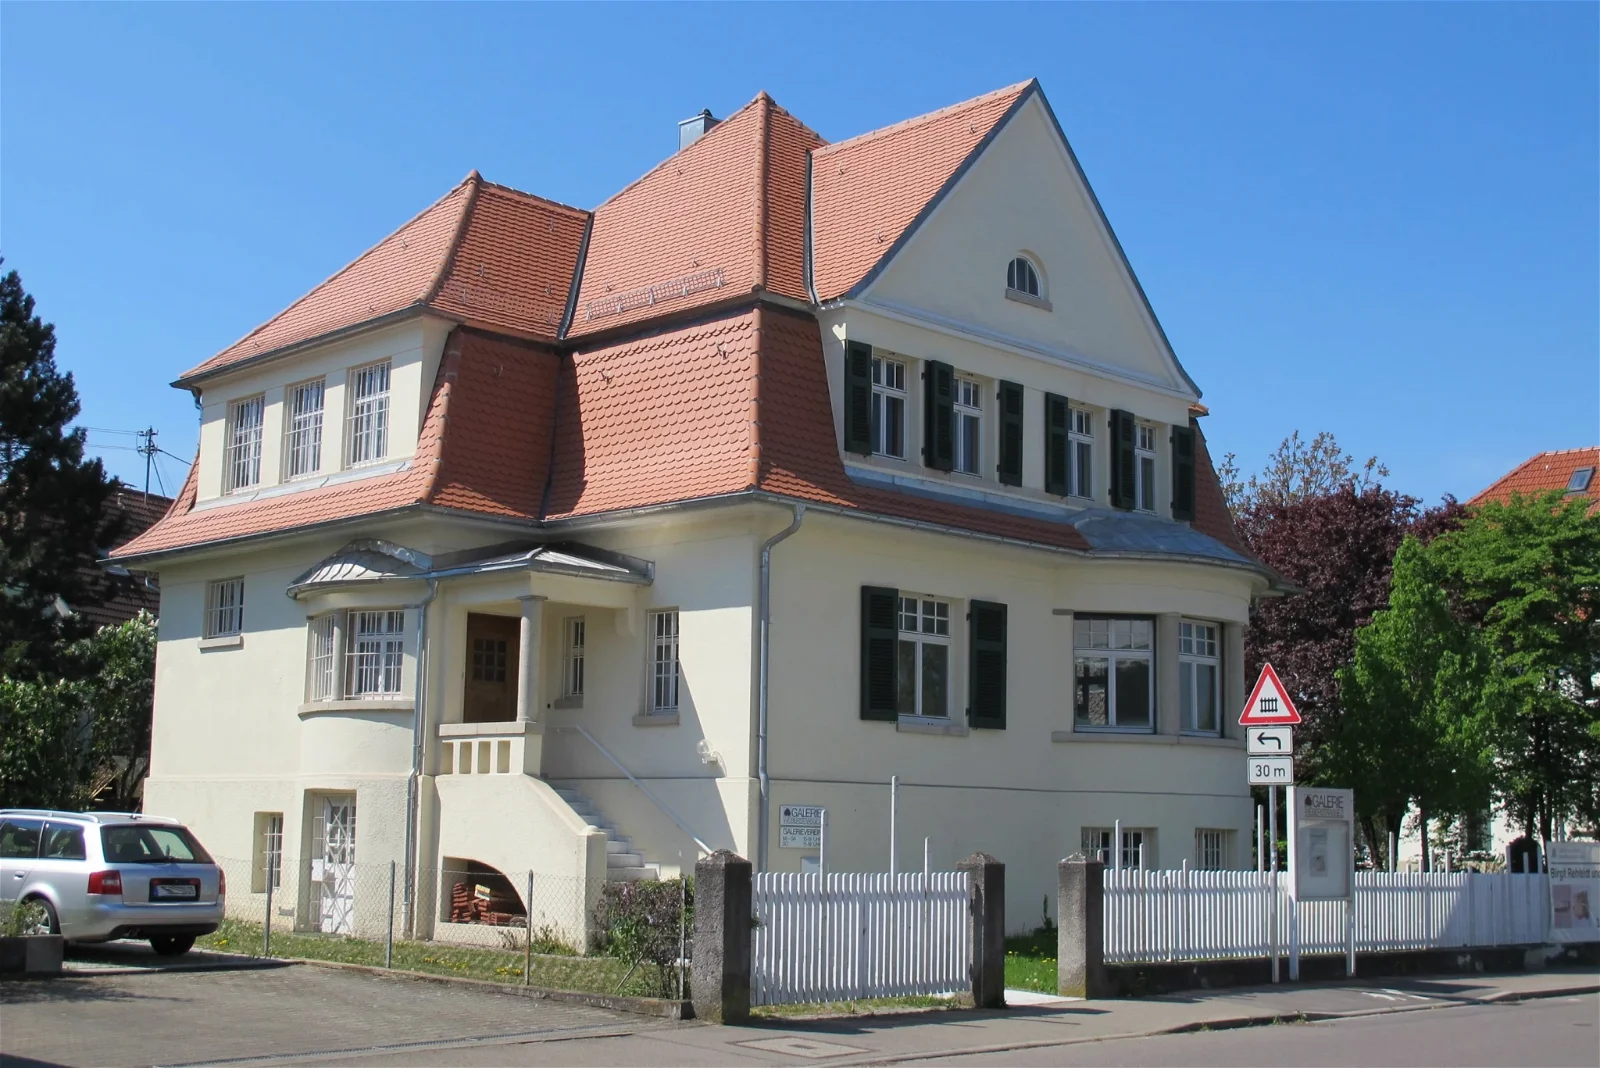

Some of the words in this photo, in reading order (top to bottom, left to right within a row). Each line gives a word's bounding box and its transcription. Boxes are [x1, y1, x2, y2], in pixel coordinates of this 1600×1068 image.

[1255, 764, 1270, 778] 30
[1274, 767, 1286, 777] m
[1312, 794, 1344, 808] GALERIE
[792, 808, 821, 818] GALERIE
